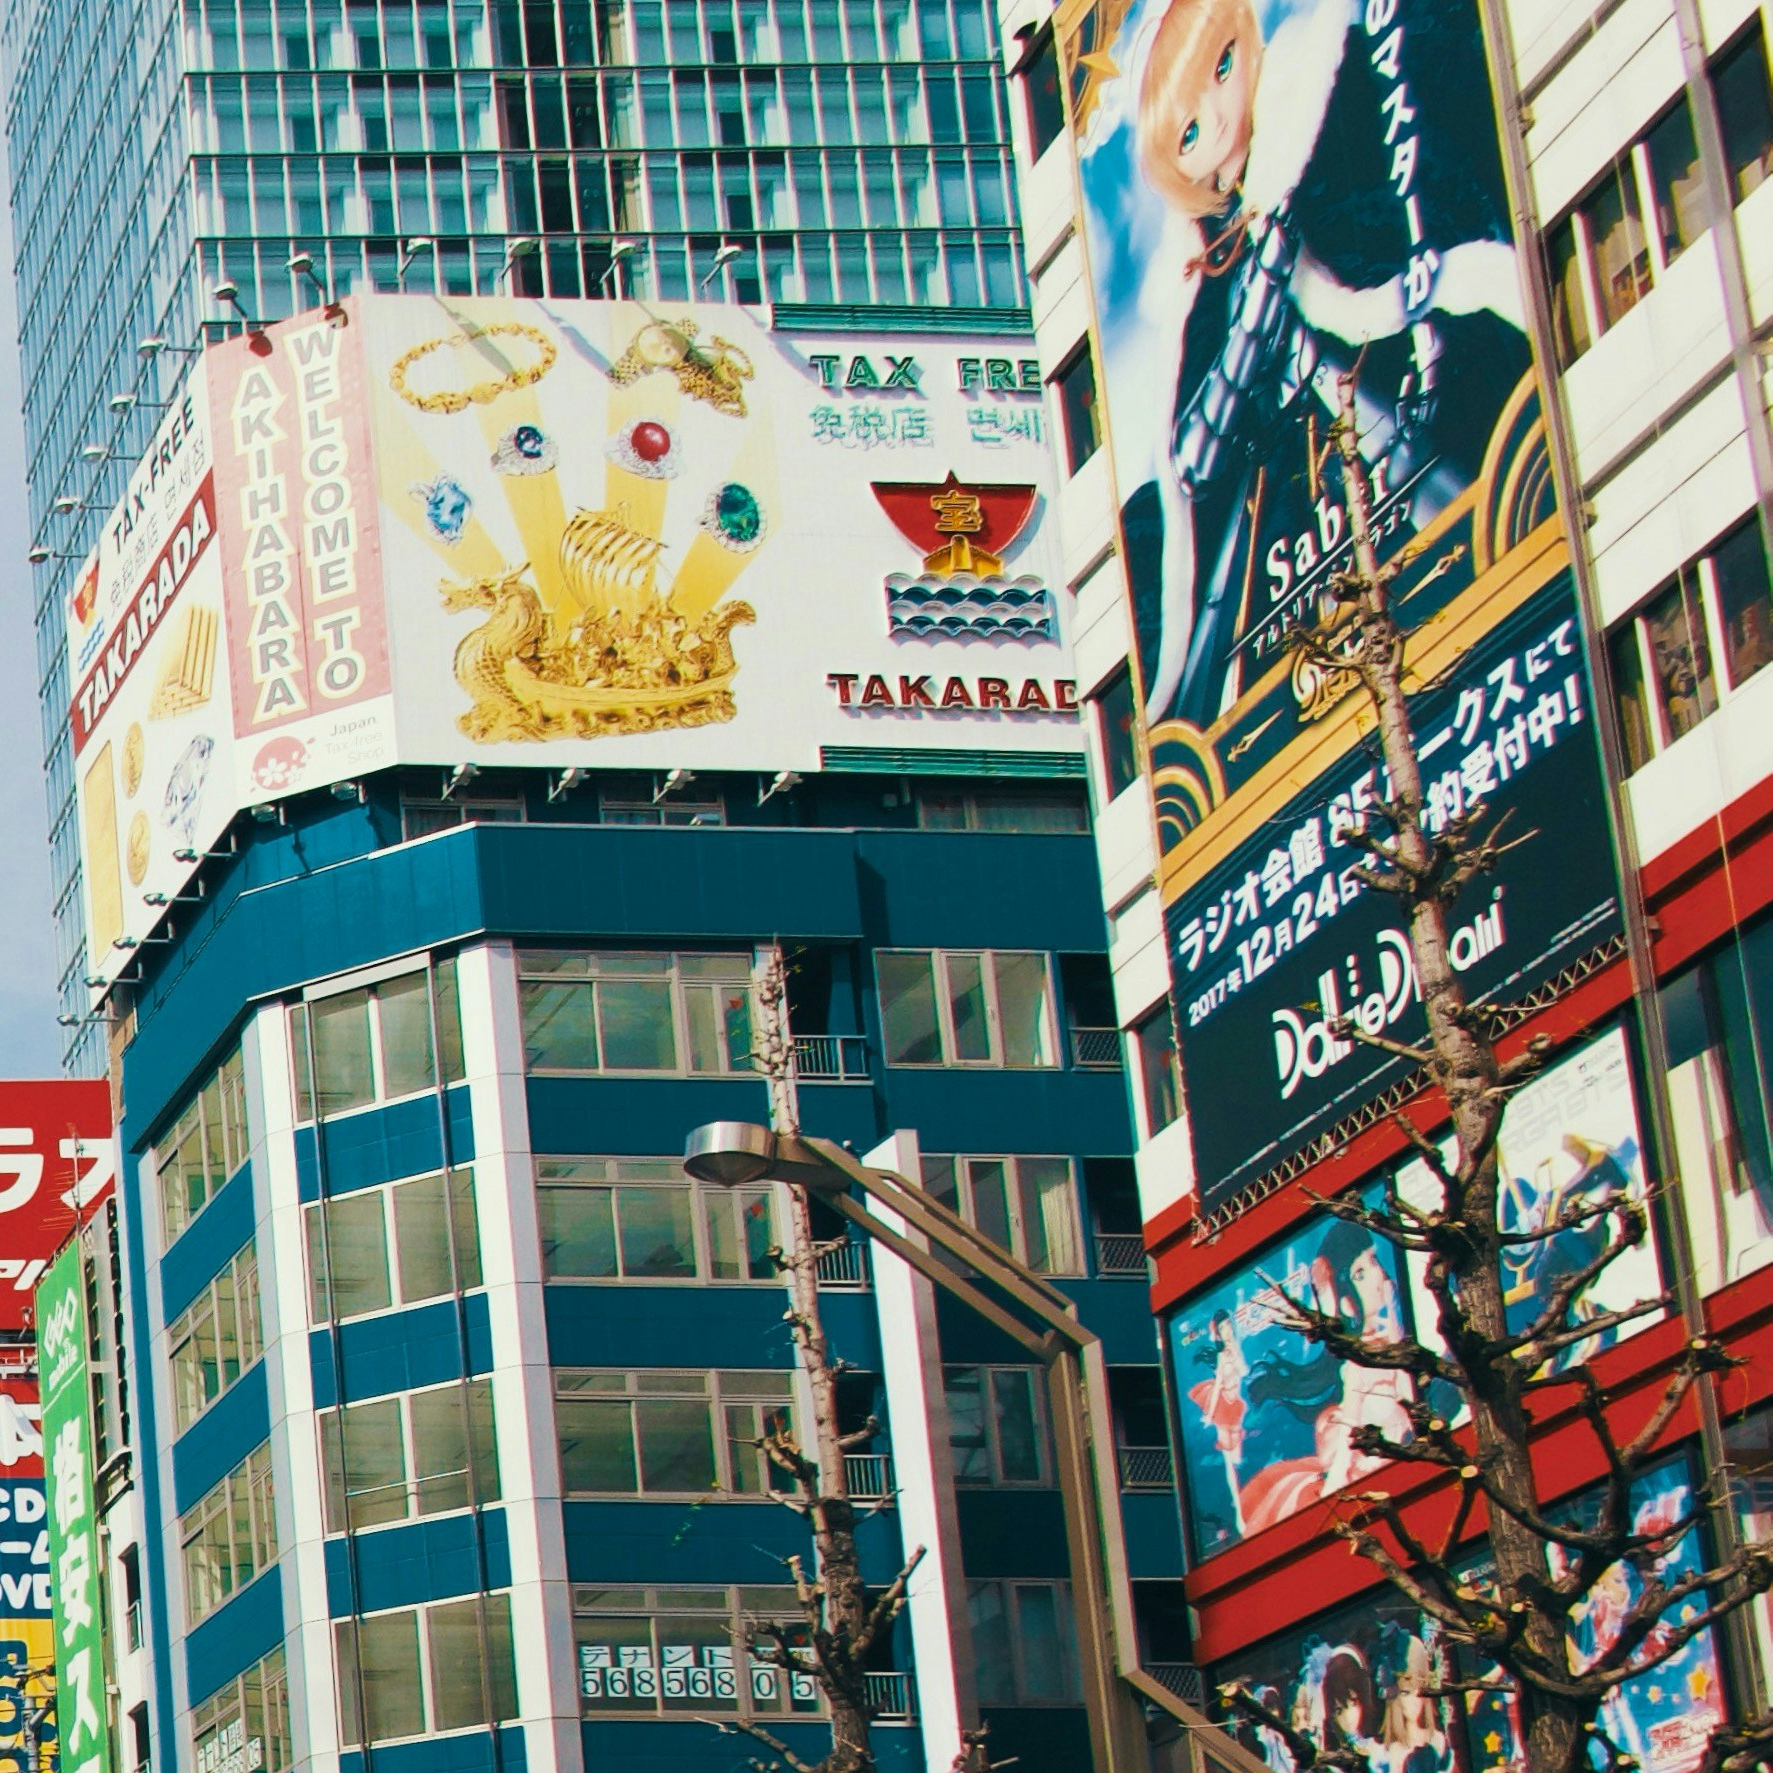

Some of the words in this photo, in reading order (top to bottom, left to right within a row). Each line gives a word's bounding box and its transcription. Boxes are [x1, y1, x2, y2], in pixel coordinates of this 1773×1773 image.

[810, 355, 917, 389] TAX
[958, 357, 1042, 391] FRE
[970, 408, 1042, 443] 면세
[112, 402, 195, 556] TAX-FREE
[290, 326, 351, 598] WELCOME
[321, 613, 357, 692] TO
[930, 490, 982, 533] 宝
[240, 367, 297, 718] AKIHABARA
[80, 496, 211, 730] TAKARADA
[828, 673, 1078, 711] TAKARAD
[347, 745, 384, 763] Shop
[1178, 823, 1325, 971] ラジオ会館
[584, 1647, 731, 1666] テナント
